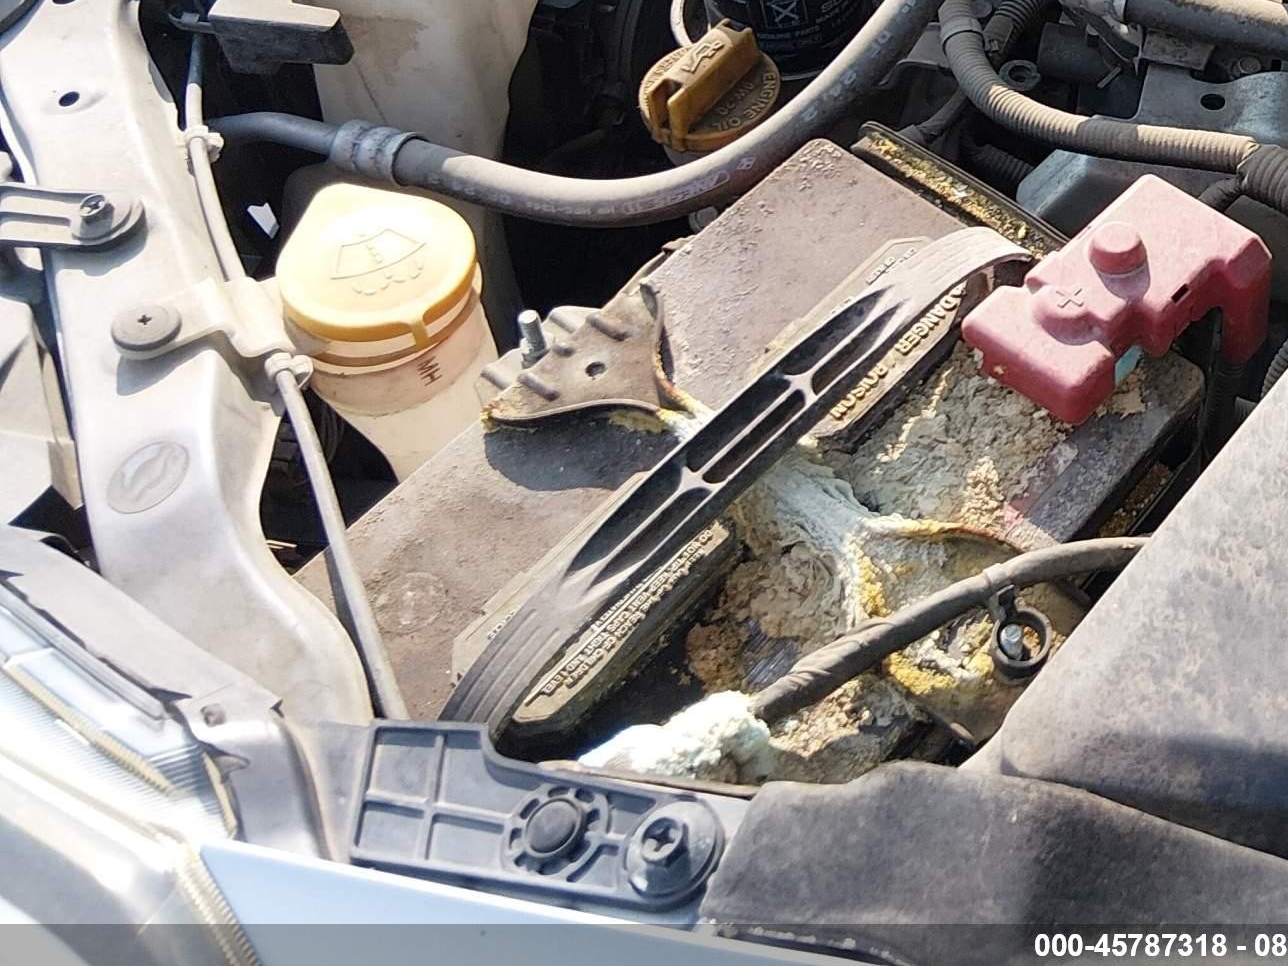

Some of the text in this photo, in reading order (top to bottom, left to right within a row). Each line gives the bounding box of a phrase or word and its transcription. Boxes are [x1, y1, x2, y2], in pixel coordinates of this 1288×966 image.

[711, 72, 777, 131] ENGINE OIL
[893, 293, 958, 357] DANGER
[699, 528, 711, 542] DO
[607, 609, 628, 632] CAPS
